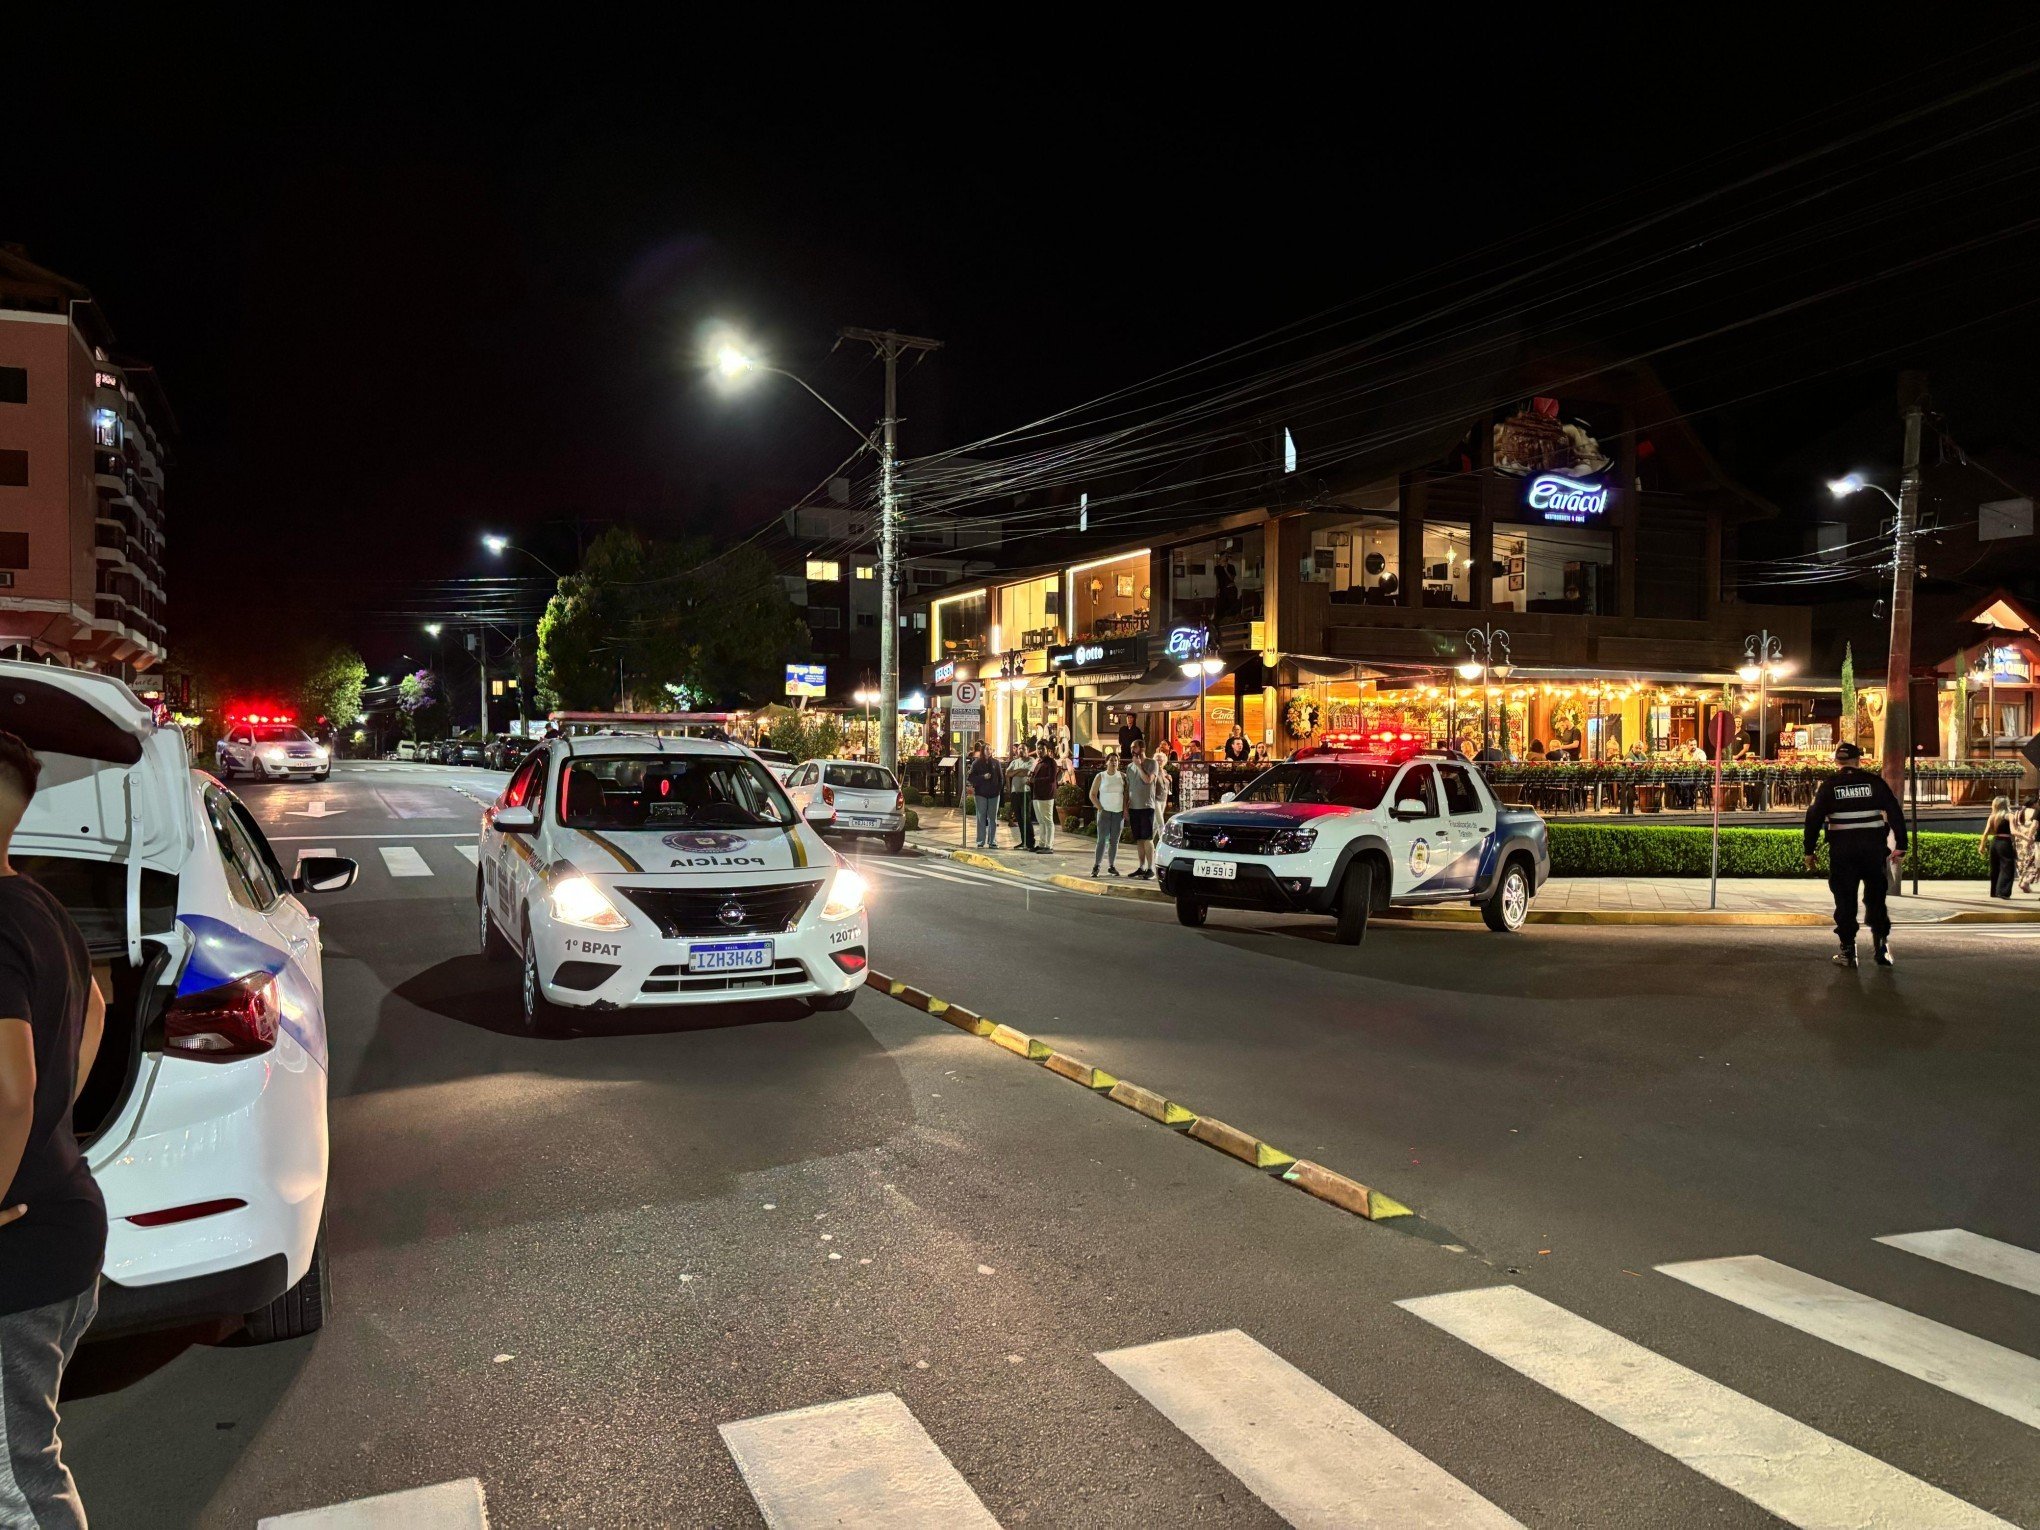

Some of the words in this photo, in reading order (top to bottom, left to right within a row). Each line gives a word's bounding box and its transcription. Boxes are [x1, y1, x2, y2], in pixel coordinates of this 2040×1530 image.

[1528, 475, 1608, 513] Caracol
[962, 686, 971, 700] E
[1836, 786, 1871, 799] TRÂNSITO
[1213, 867, 1234, 877] 5913
[582, 941, 622, 956] BPAT
[697, 951, 763, 969] IZH3H48
